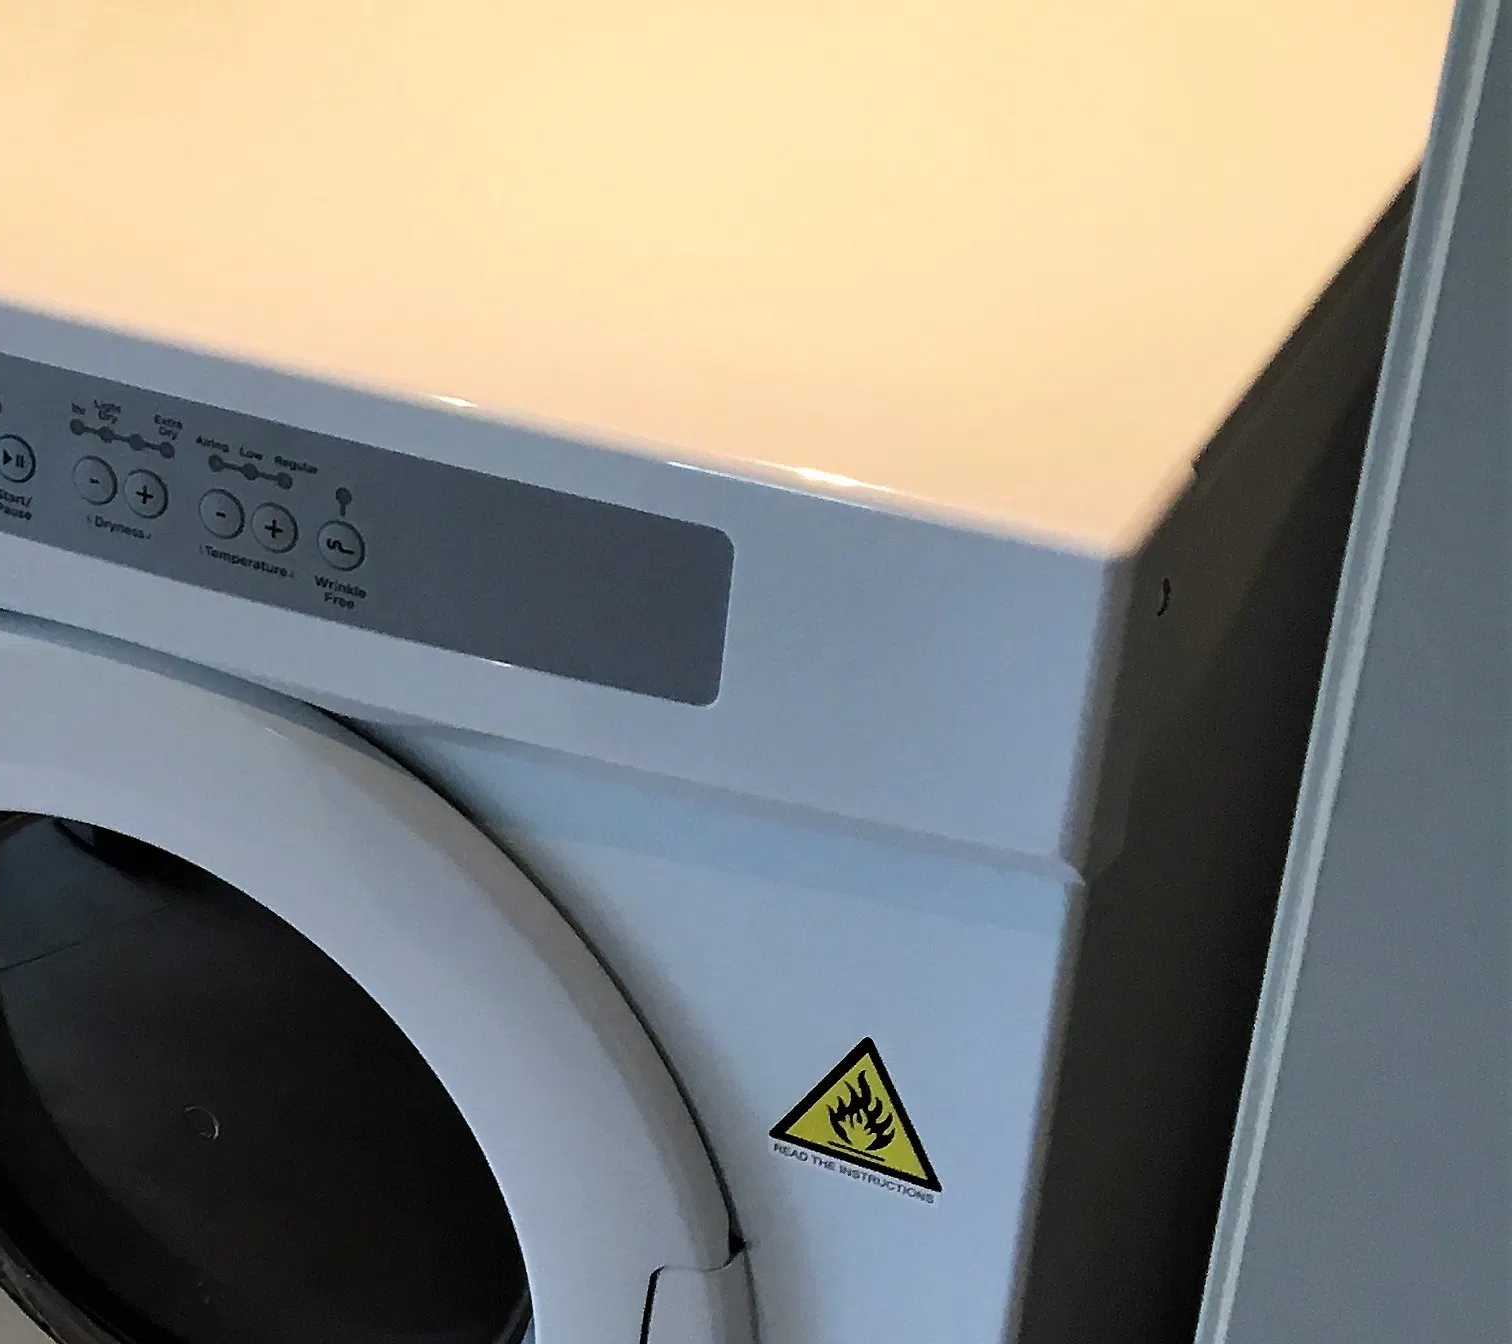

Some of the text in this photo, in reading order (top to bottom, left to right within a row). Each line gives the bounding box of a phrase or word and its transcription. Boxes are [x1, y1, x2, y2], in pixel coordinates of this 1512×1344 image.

[154, 414, 183, 430] Extra
[239, 445, 263, 461] Low
[274, 455, 318, 474] Regular
[95, 515, 145, 540] Dryness
[204, 545, 288, 577] Temperature
[314, 575, 367, 599] Wrinkle
[324, 592, 355, 610] Free
[774, 1143, 934, 1204] READ THE INSTRUCTIONS
